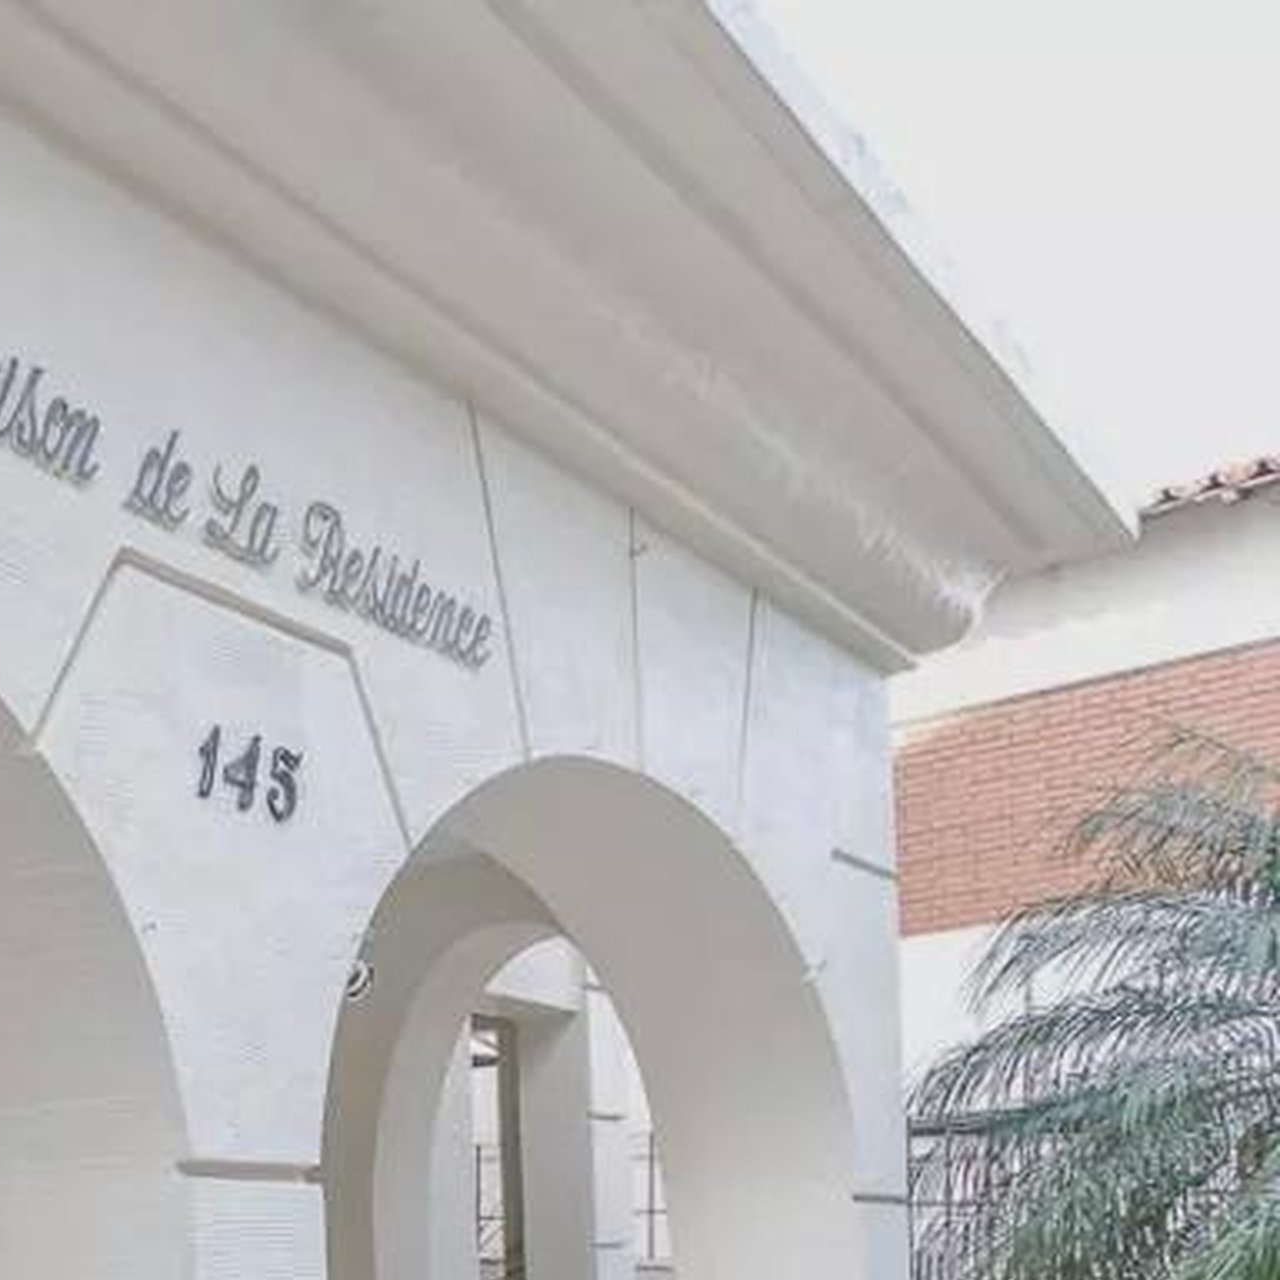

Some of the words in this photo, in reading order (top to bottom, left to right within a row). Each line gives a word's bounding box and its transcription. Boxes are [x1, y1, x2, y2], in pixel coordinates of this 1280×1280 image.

[125, 430, 193, 524] de
[206, 464, 278, 560] La
[300, 502, 492, 664] Residence
[197, 724, 303, 822] 145
